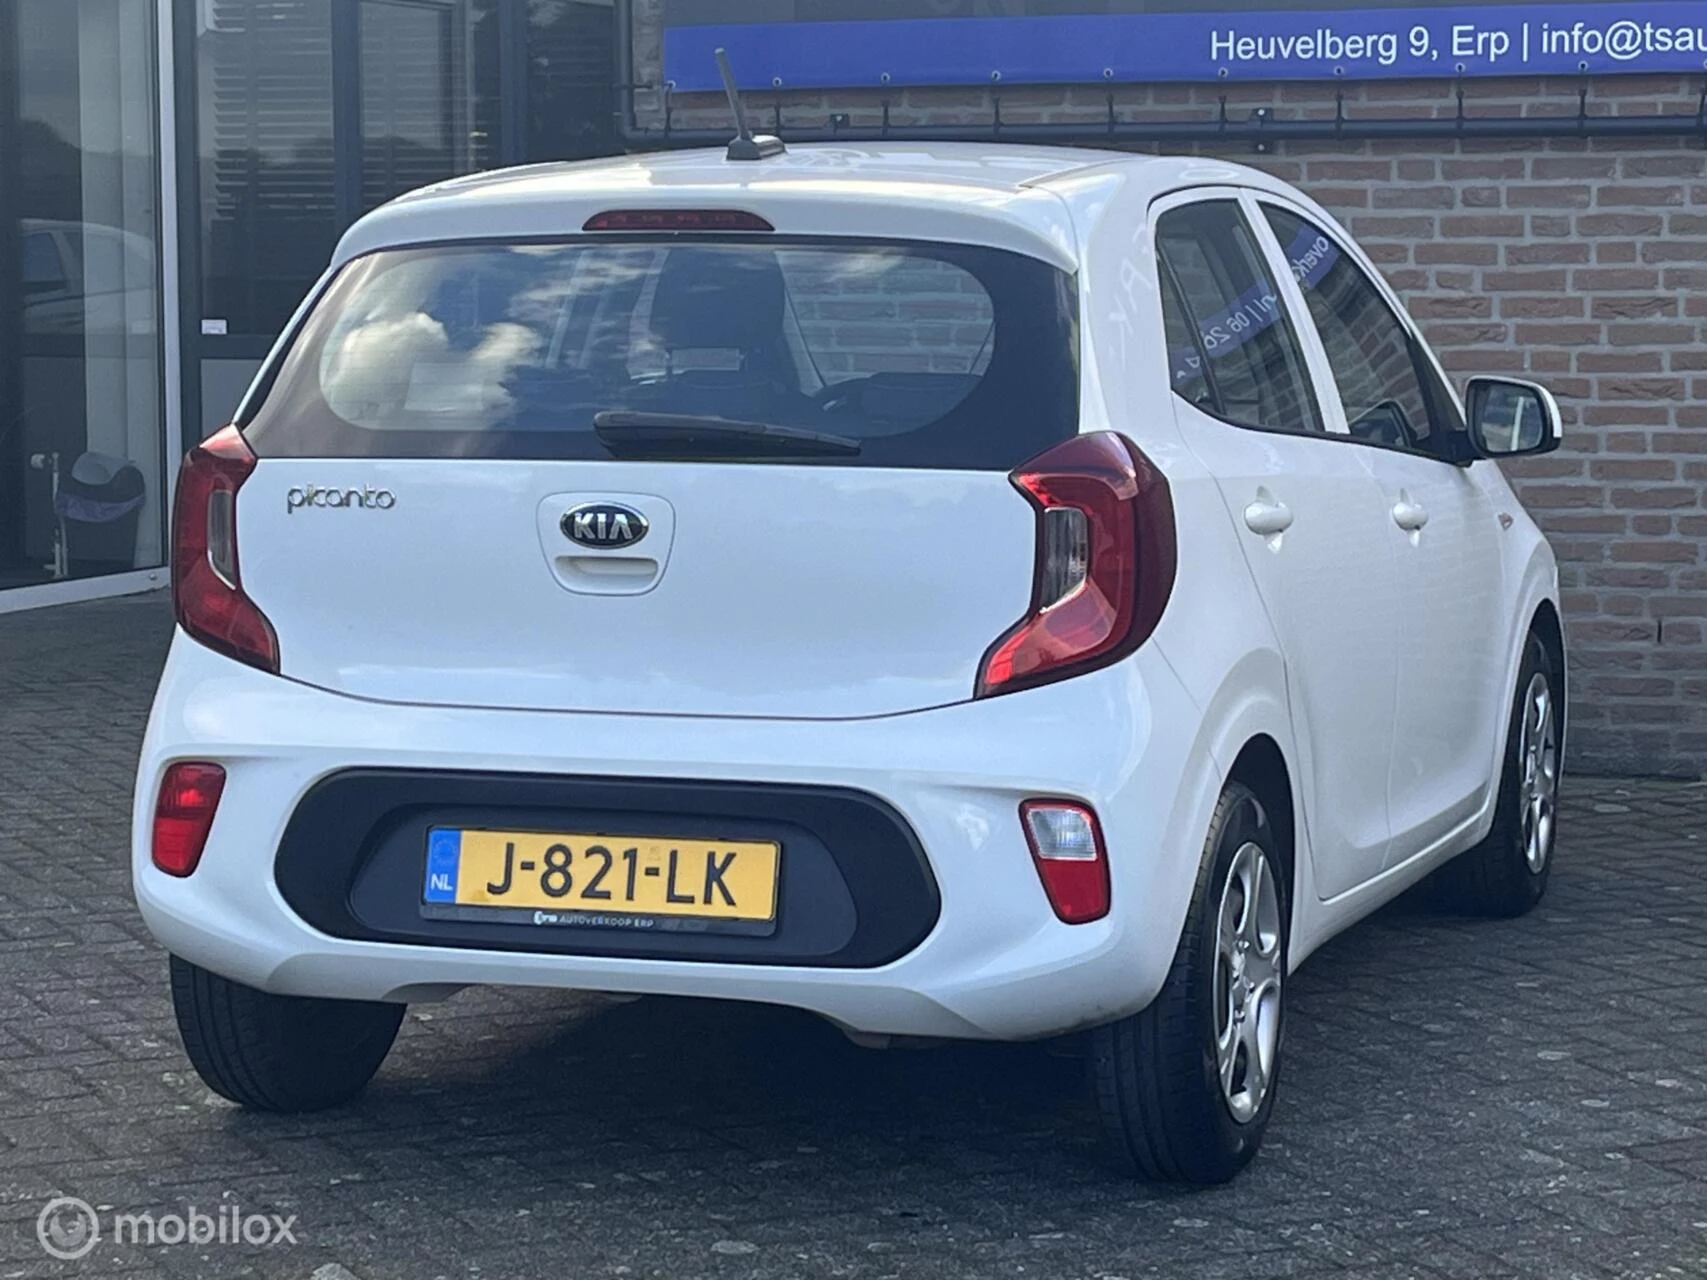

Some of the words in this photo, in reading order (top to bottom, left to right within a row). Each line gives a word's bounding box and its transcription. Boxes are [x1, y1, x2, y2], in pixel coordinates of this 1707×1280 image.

[1210, 28, 1397, 65] Heuvelberg
[1408, 25, 1439, 61] 9,
[1451, 24, 1509, 62] Erp
[287, 484, 396, 514] picanto
[573, 512, 634, 540] KIA
[430, 876, 453, 892] NL
[486, 842, 737, 907] J-821-LK
